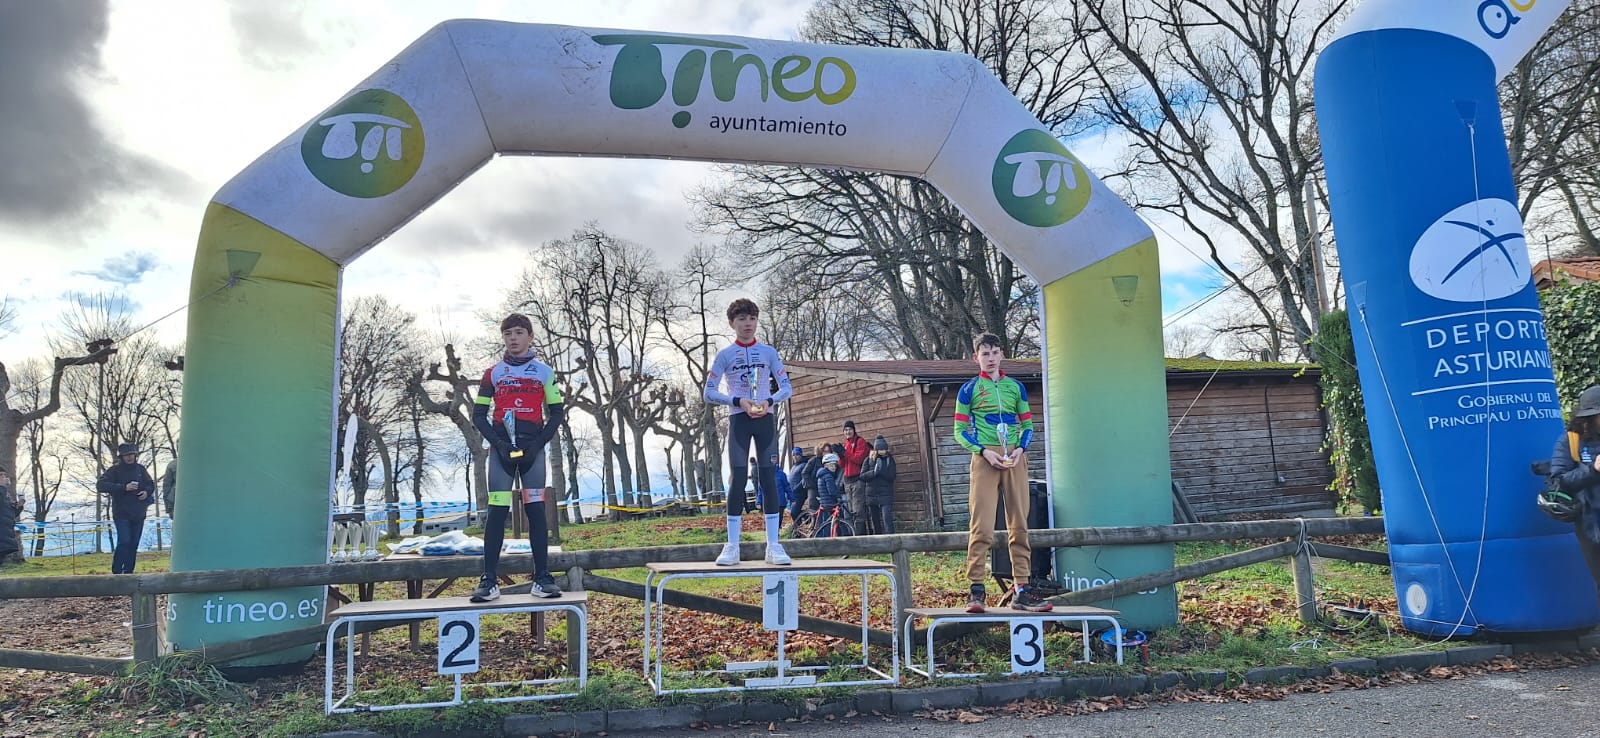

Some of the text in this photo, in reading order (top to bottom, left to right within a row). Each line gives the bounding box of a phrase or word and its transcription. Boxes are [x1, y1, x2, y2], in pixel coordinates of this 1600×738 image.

[591, 34, 857, 129] Tineo
[709, 115, 847, 137] ayuntamiento
[203, 596, 318, 624] tineo.es
[766, 580, 785, 626] 1
[442, 620, 476, 668] 2
[1013, 623, 1042, 667] 3
